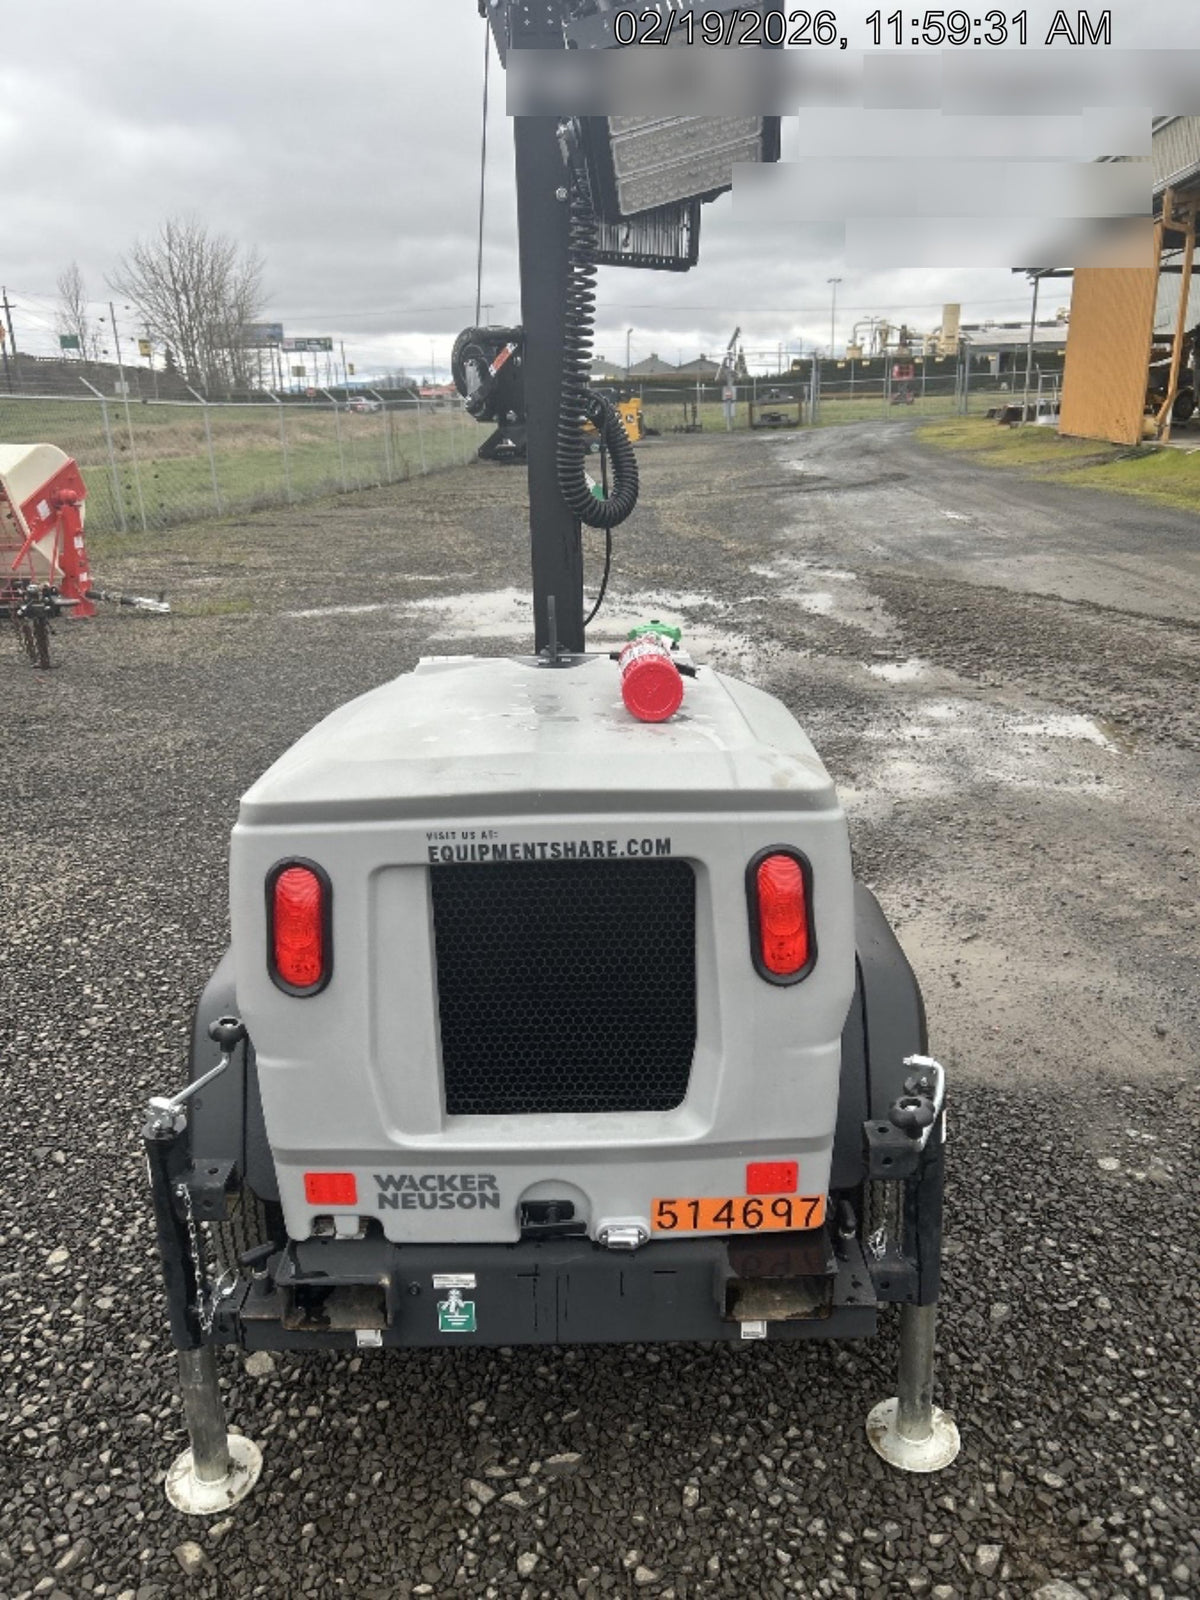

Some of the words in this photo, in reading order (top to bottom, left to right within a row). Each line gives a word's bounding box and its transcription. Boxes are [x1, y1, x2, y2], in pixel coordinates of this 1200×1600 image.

[426, 831, 456, 840] VISIT
[461, 831, 475, 840] US
[427, 837, 672, 863] EQUIPMENTSHARE.COM
[372, 1174, 499, 1192] WACKER
[378, 1192, 500, 1210] NEUSON
[656, 1196, 821, 1230] 514697
